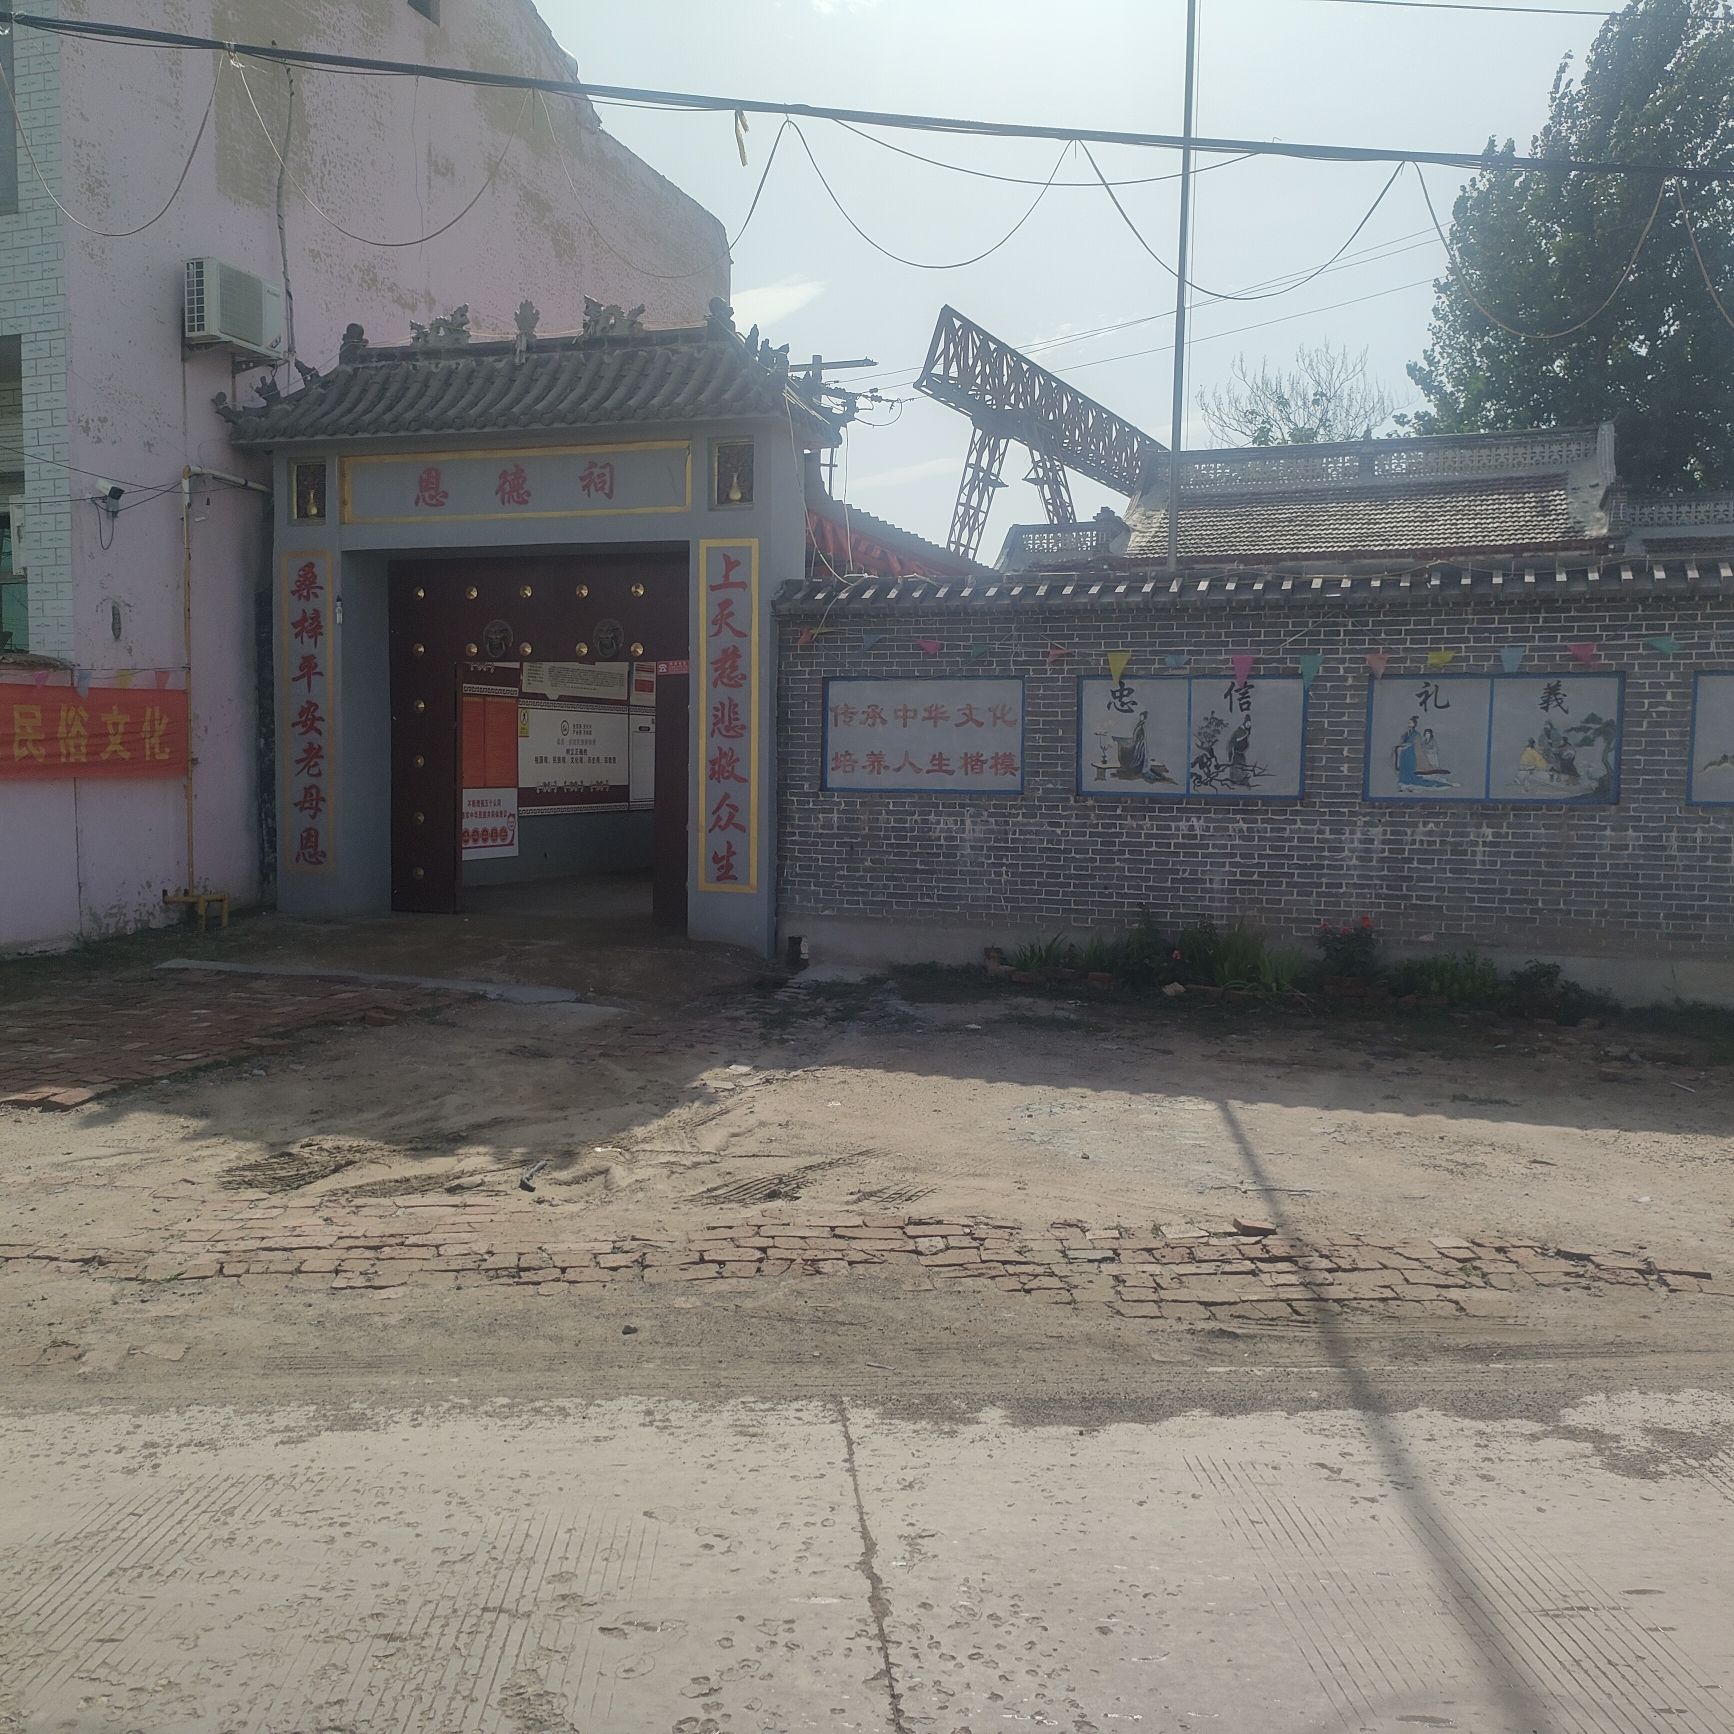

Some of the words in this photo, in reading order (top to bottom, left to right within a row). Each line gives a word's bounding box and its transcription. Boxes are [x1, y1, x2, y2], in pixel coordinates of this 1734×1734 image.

[415, 460, 615, 508] 恩德祠
[1106, 681, 1139, 715] 忠
[1223, 681, 1255, 714] 信
[1414, 680, 1450, 713] 礼
[1538, 680, 1571, 715] 義
[291, 561, 327, 867] 桑梓平安老母恩
[709, 552, 748, 882] 上天慈悲救众生
[829, 702, 1019, 729] 传承中华文化
[12, 703, 171, 763] 民俗文化
[829, 749, 1021, 777] 培养人生楷模
